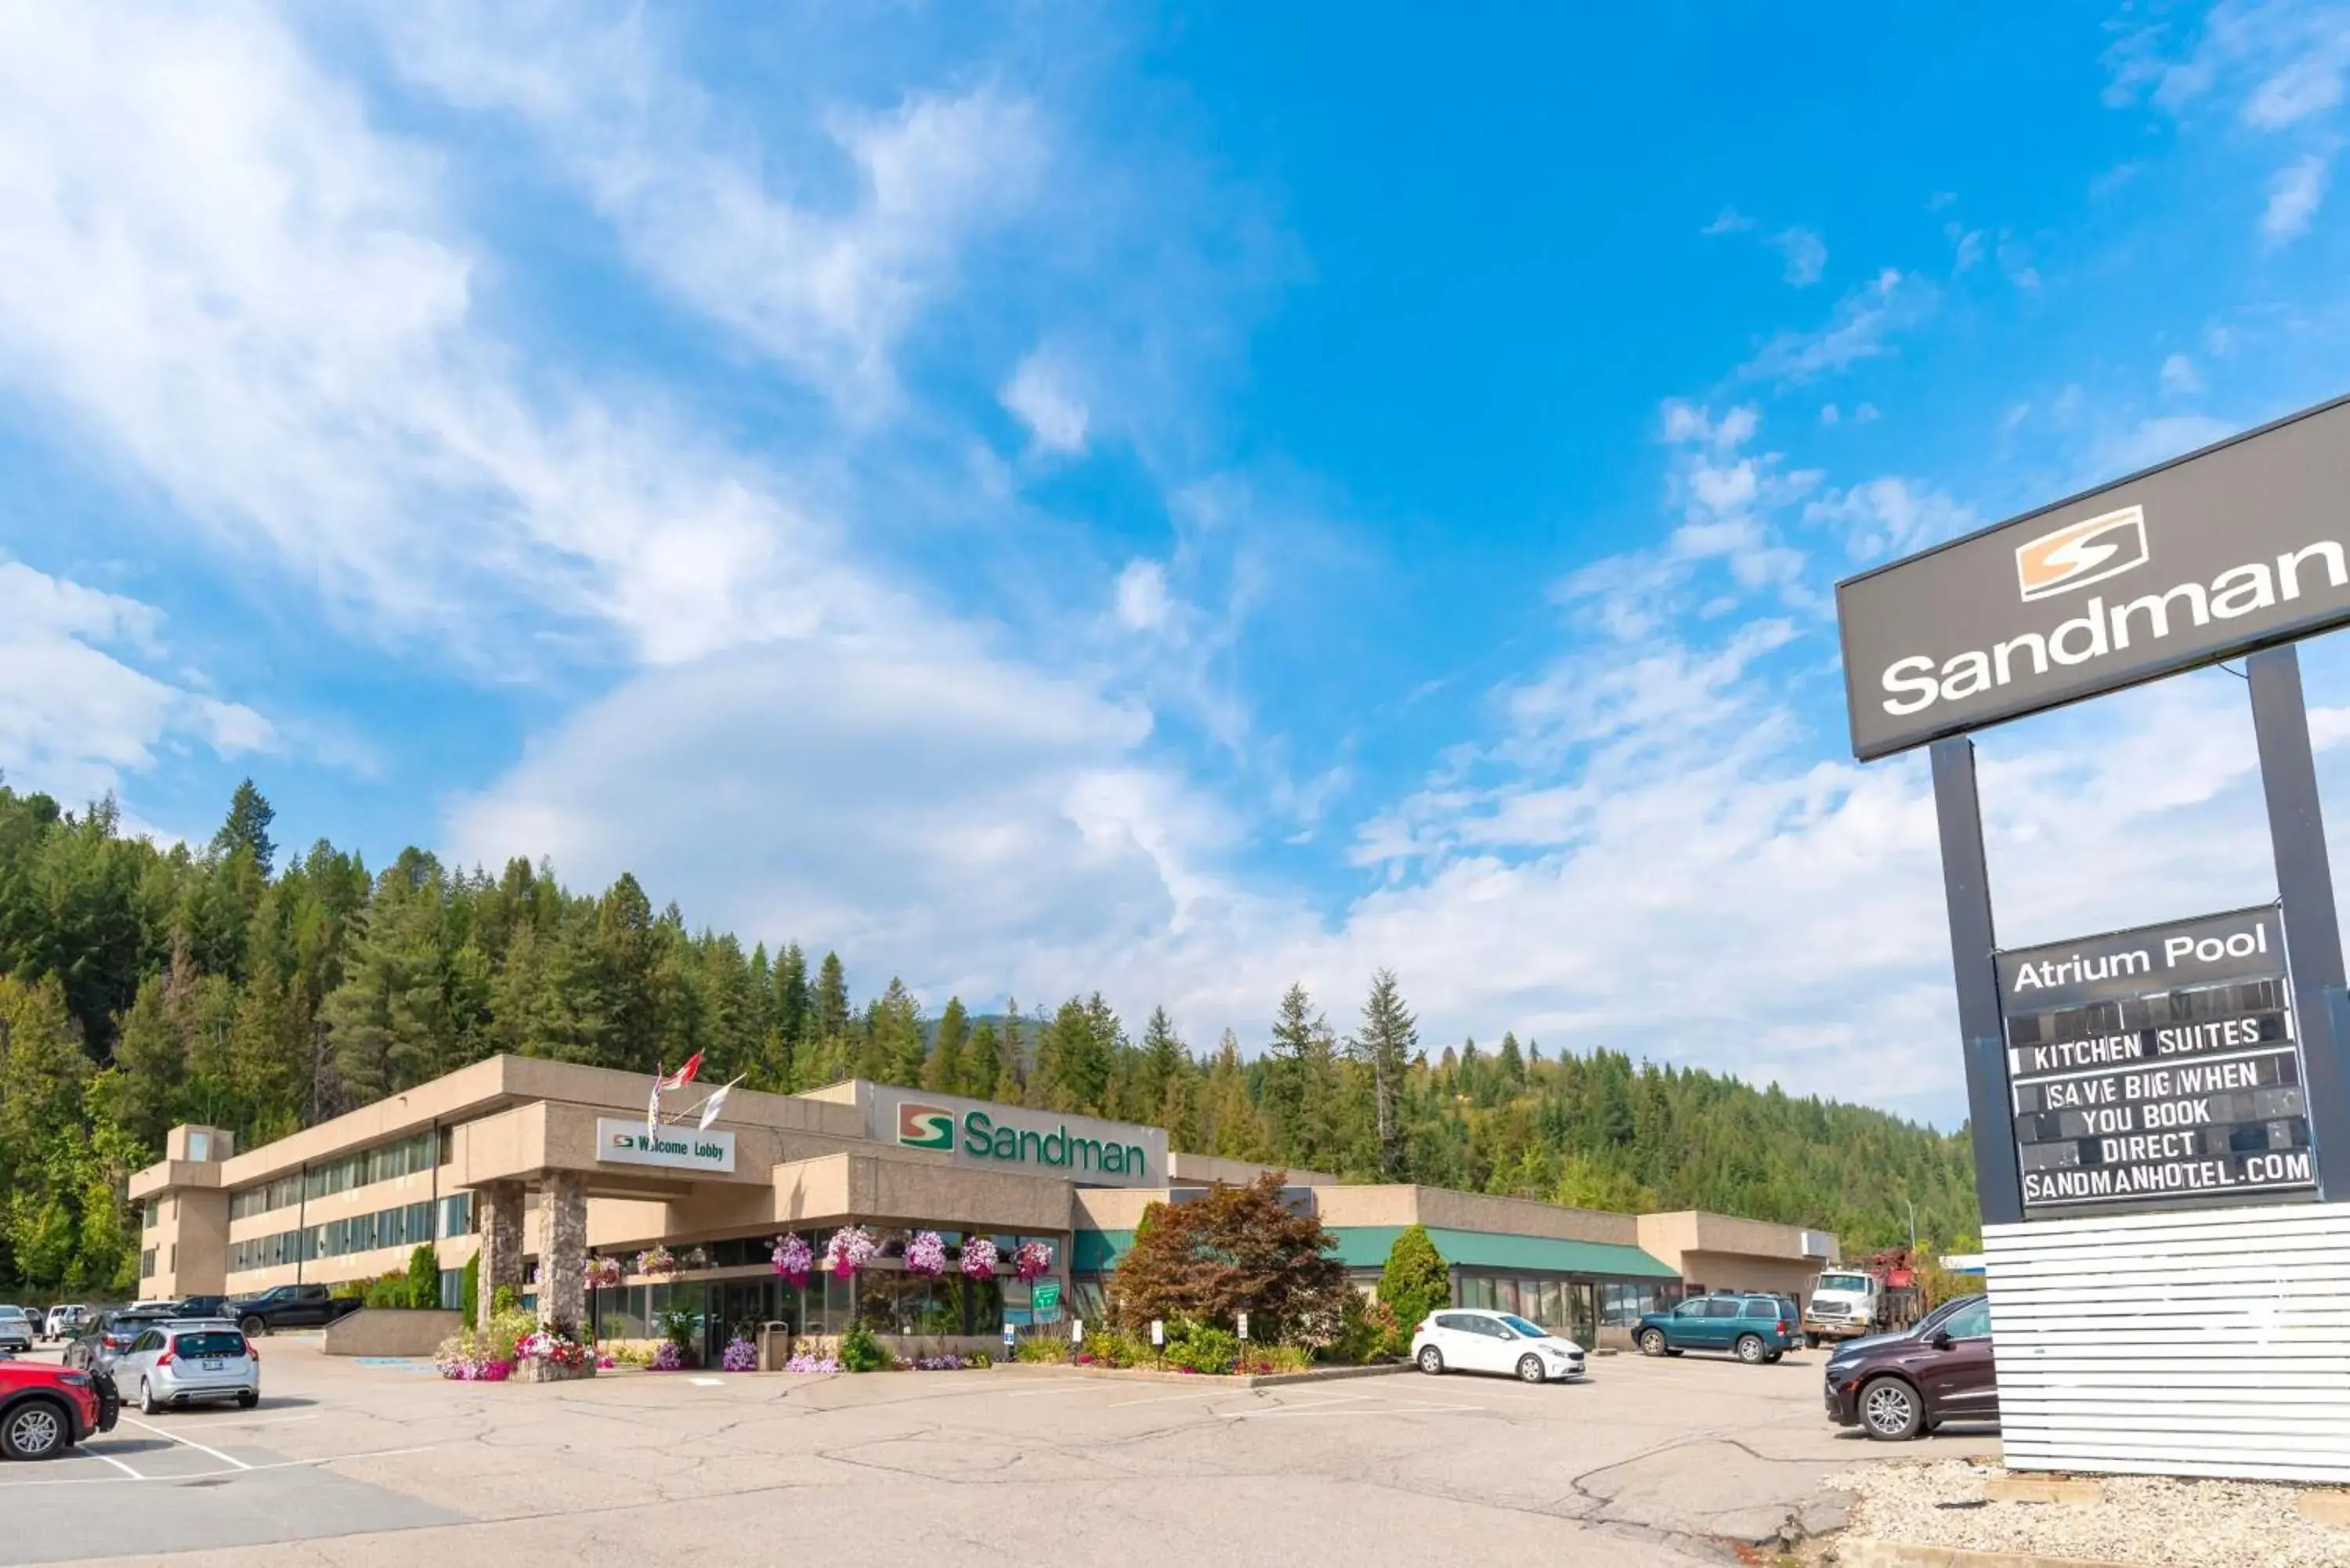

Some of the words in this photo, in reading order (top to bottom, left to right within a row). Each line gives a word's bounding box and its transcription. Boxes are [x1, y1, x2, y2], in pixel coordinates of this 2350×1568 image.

[1882, 540, 2349, 717] Sandman
[2013, 948, 2150, 992] Atrium
[2164, 923, 2268, 968] Pool
[2034, 1033, 2142, 1071] KITCHEN
[2158, 1018, 2260, 1054] SUITES
[2048, 1076, 2116, 1109] SAVE
[2124, 1071, 2170, 1100] BIG
[2178, 1061, 2258, 1094] WHEN
[2081, 1107, 2132, 1135] YOU
[2142, 1097, 2211, 1129] BOOK
[638, 1135, 688, 1155] Wlcome
[694, 1141, 725, 1162] Lobby
[963, 1110, 1146, 1177] Sandman
[2102, 1132, 2196, 1163] DIRECT
[2025, 1153, 2312, 1198] SANDMANHOTEL.COM
